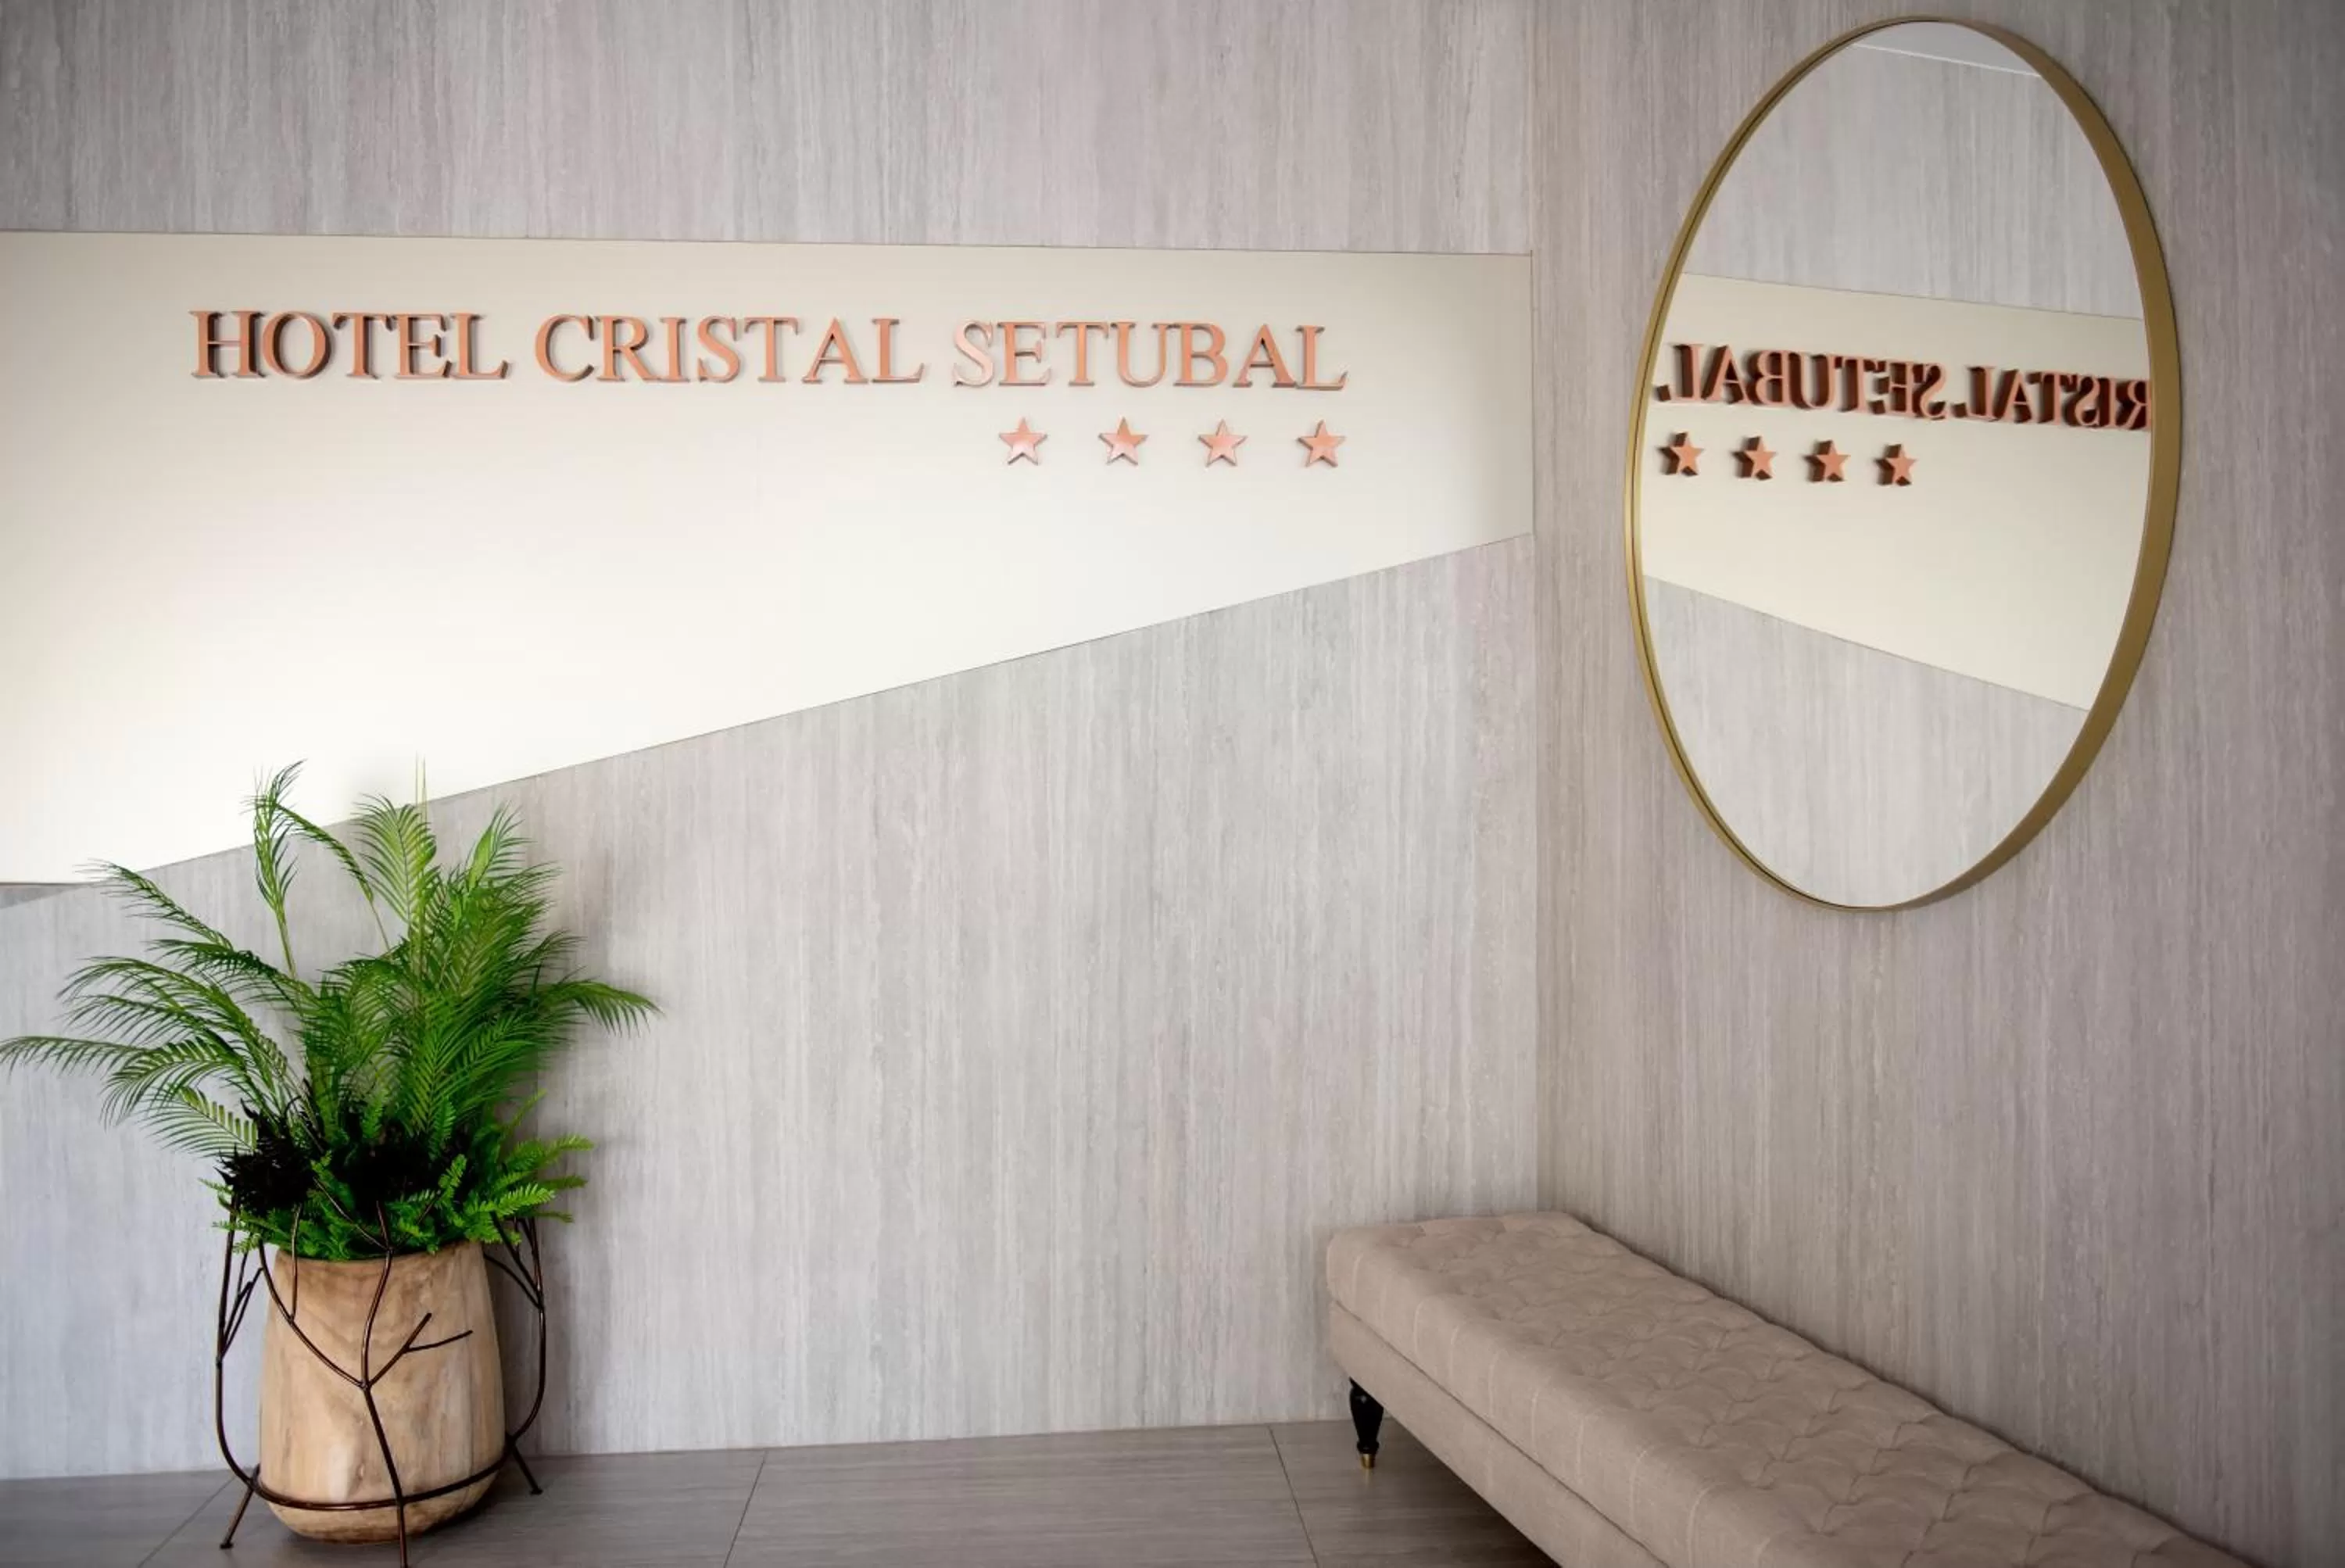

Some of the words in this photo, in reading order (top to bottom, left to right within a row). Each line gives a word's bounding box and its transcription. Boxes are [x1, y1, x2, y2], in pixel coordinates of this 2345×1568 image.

[191, 310, 510, 380] HOTEL
[535, 314, 925, 384] CRISTAL
[952, 319, 1348, 391] SETUBAL
